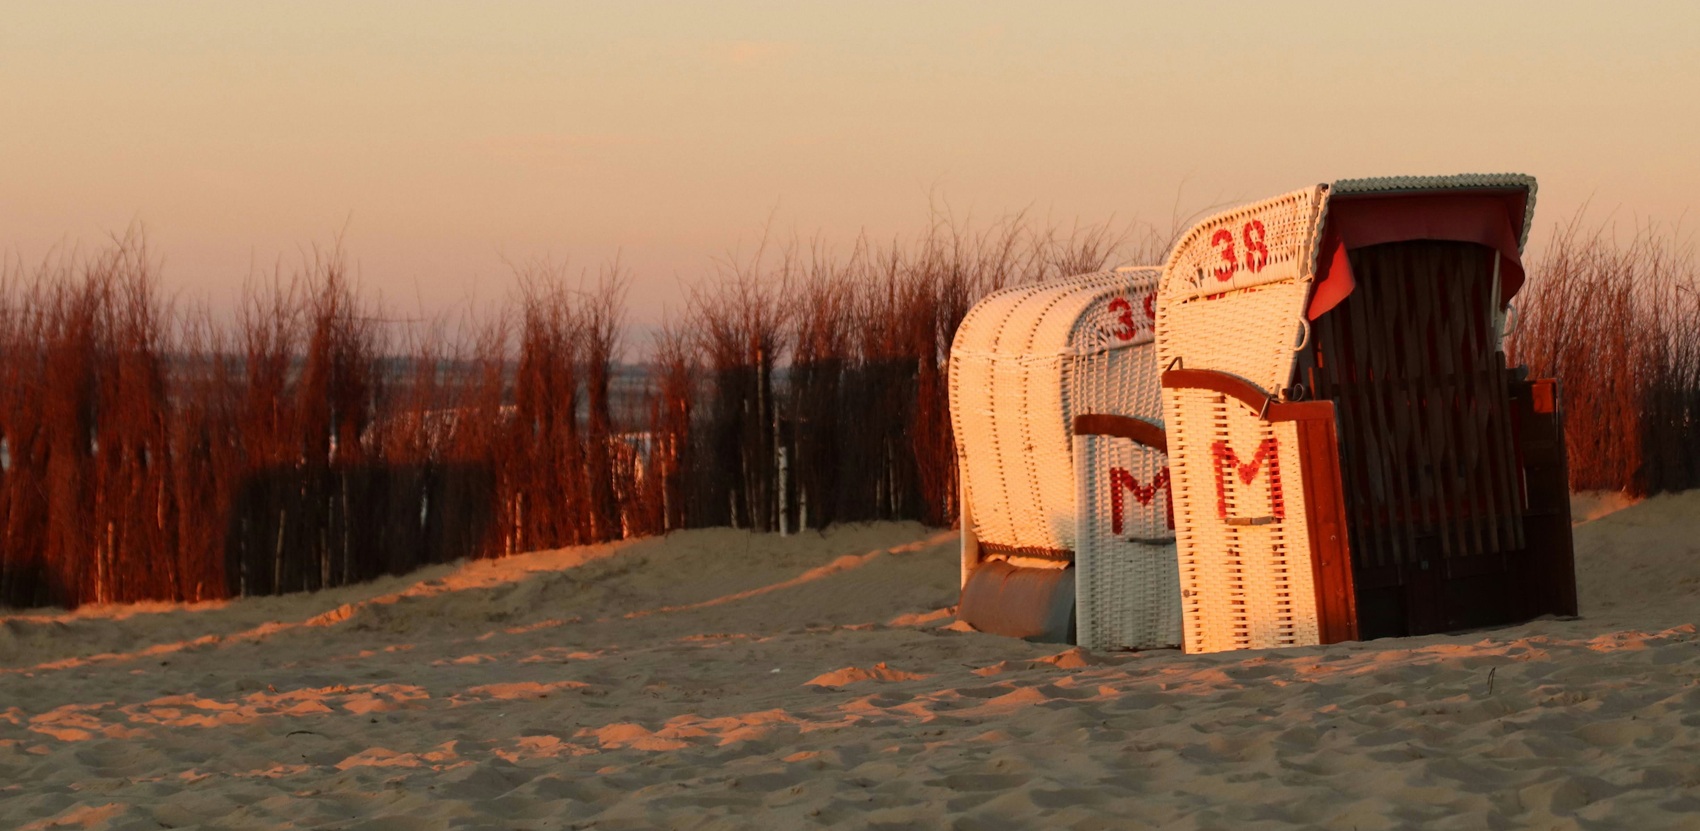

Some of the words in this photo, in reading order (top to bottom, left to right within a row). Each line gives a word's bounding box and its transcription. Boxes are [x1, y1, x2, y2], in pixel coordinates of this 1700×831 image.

[1211, 219, 1268, 282] 38
[1110, 466, 1175, 535] M
[1212, 438, 1285, 519] M
